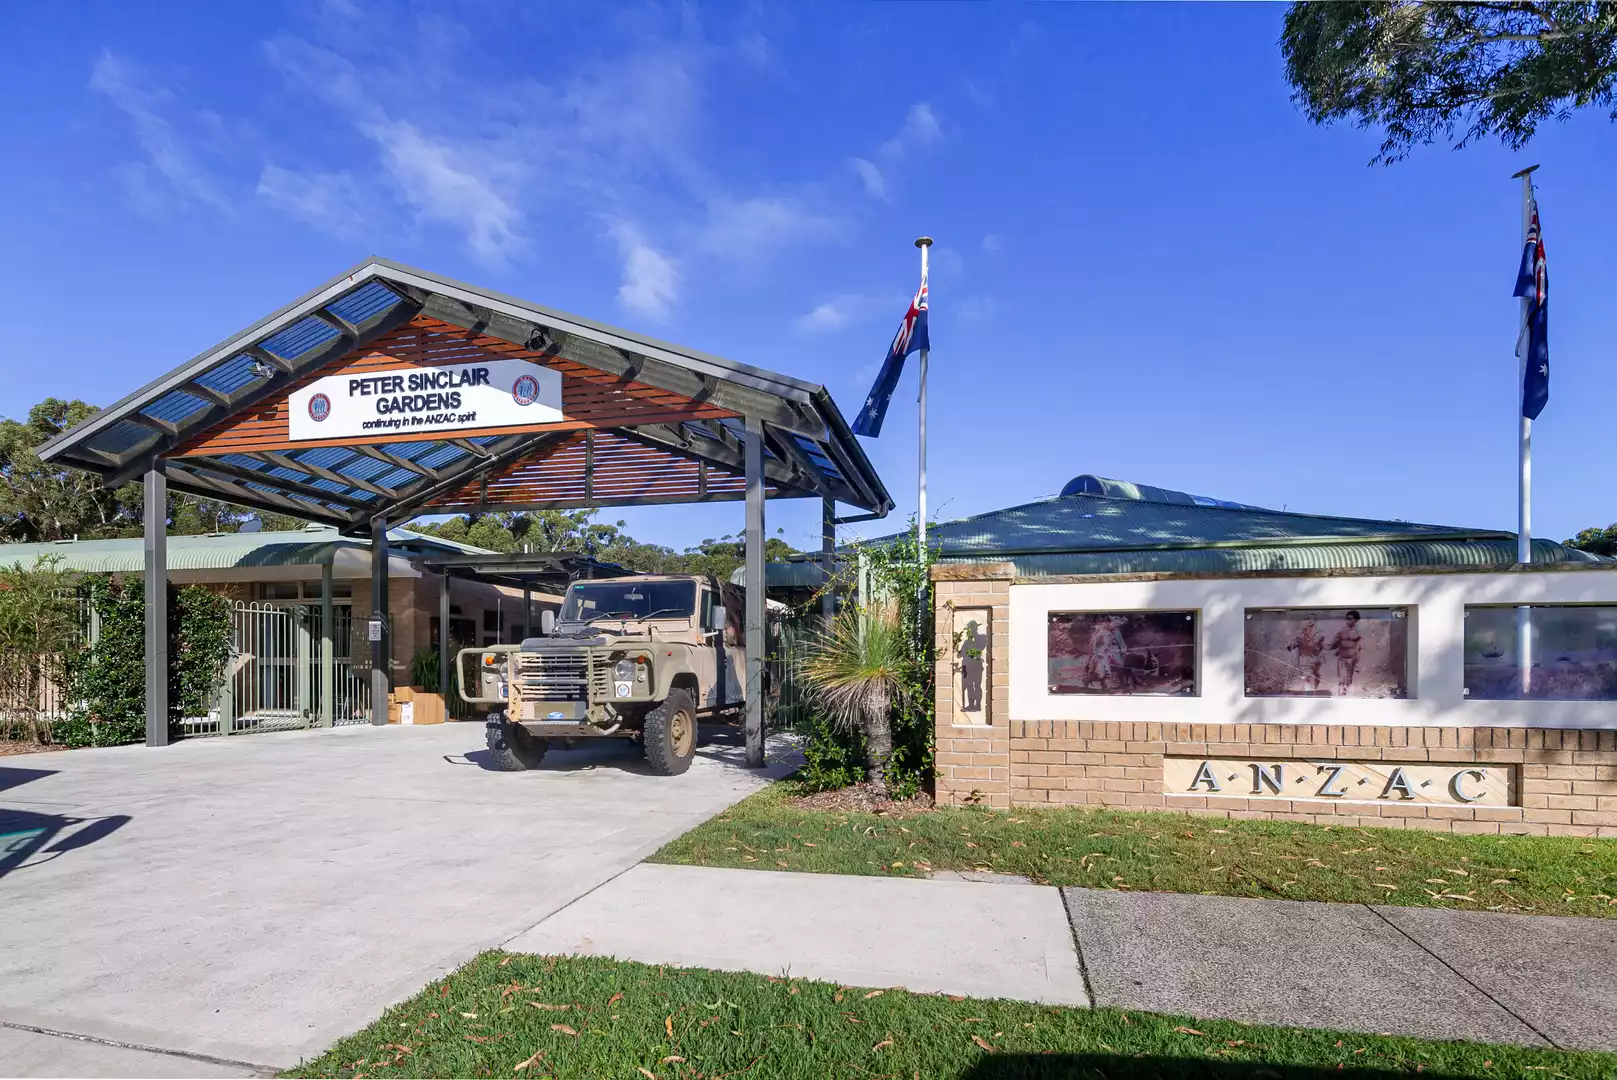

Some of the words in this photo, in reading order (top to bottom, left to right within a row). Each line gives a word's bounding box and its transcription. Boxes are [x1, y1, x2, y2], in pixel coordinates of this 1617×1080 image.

[349, 375, 405, 397] PETER
[408, 367, 490, 392] SINCLAIR
[376, 391, 462, 415] GARDENS
[362, 417, 401, 430] continuing
[402, 416, 410, 427] in
[411, 415, 423, 426] the
[424, 412, 456, 425] ANZAC
[457, 411, 477, 424] spirit
